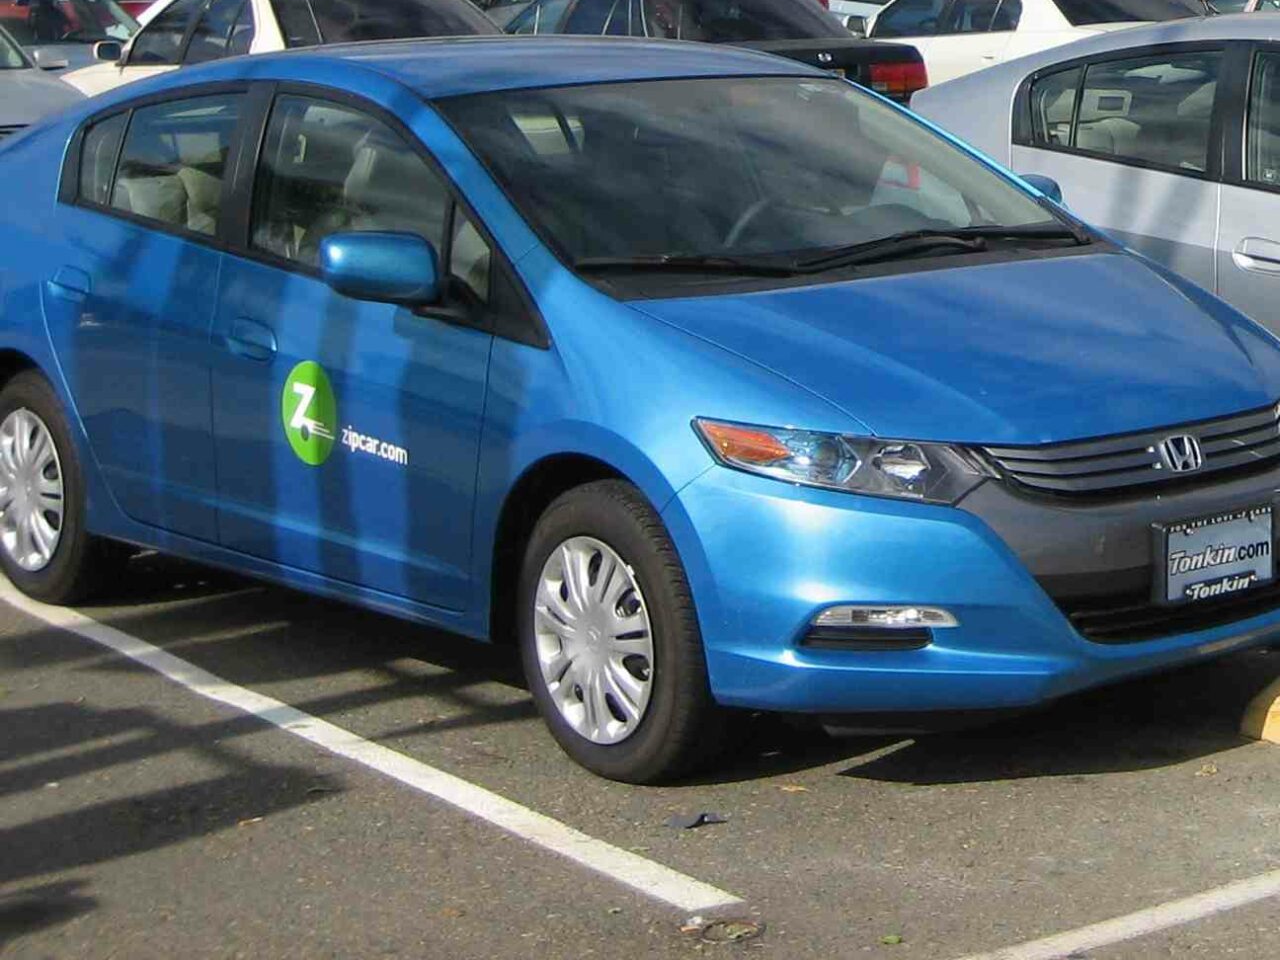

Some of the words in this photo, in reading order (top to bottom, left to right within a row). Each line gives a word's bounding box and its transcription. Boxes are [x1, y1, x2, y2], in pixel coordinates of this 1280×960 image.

[341, 425, 408, 465] zipcar.com
[1169, 541, 1269, 576] Tonkin.com
[1190, 576, 1250, 601] Tonkin
